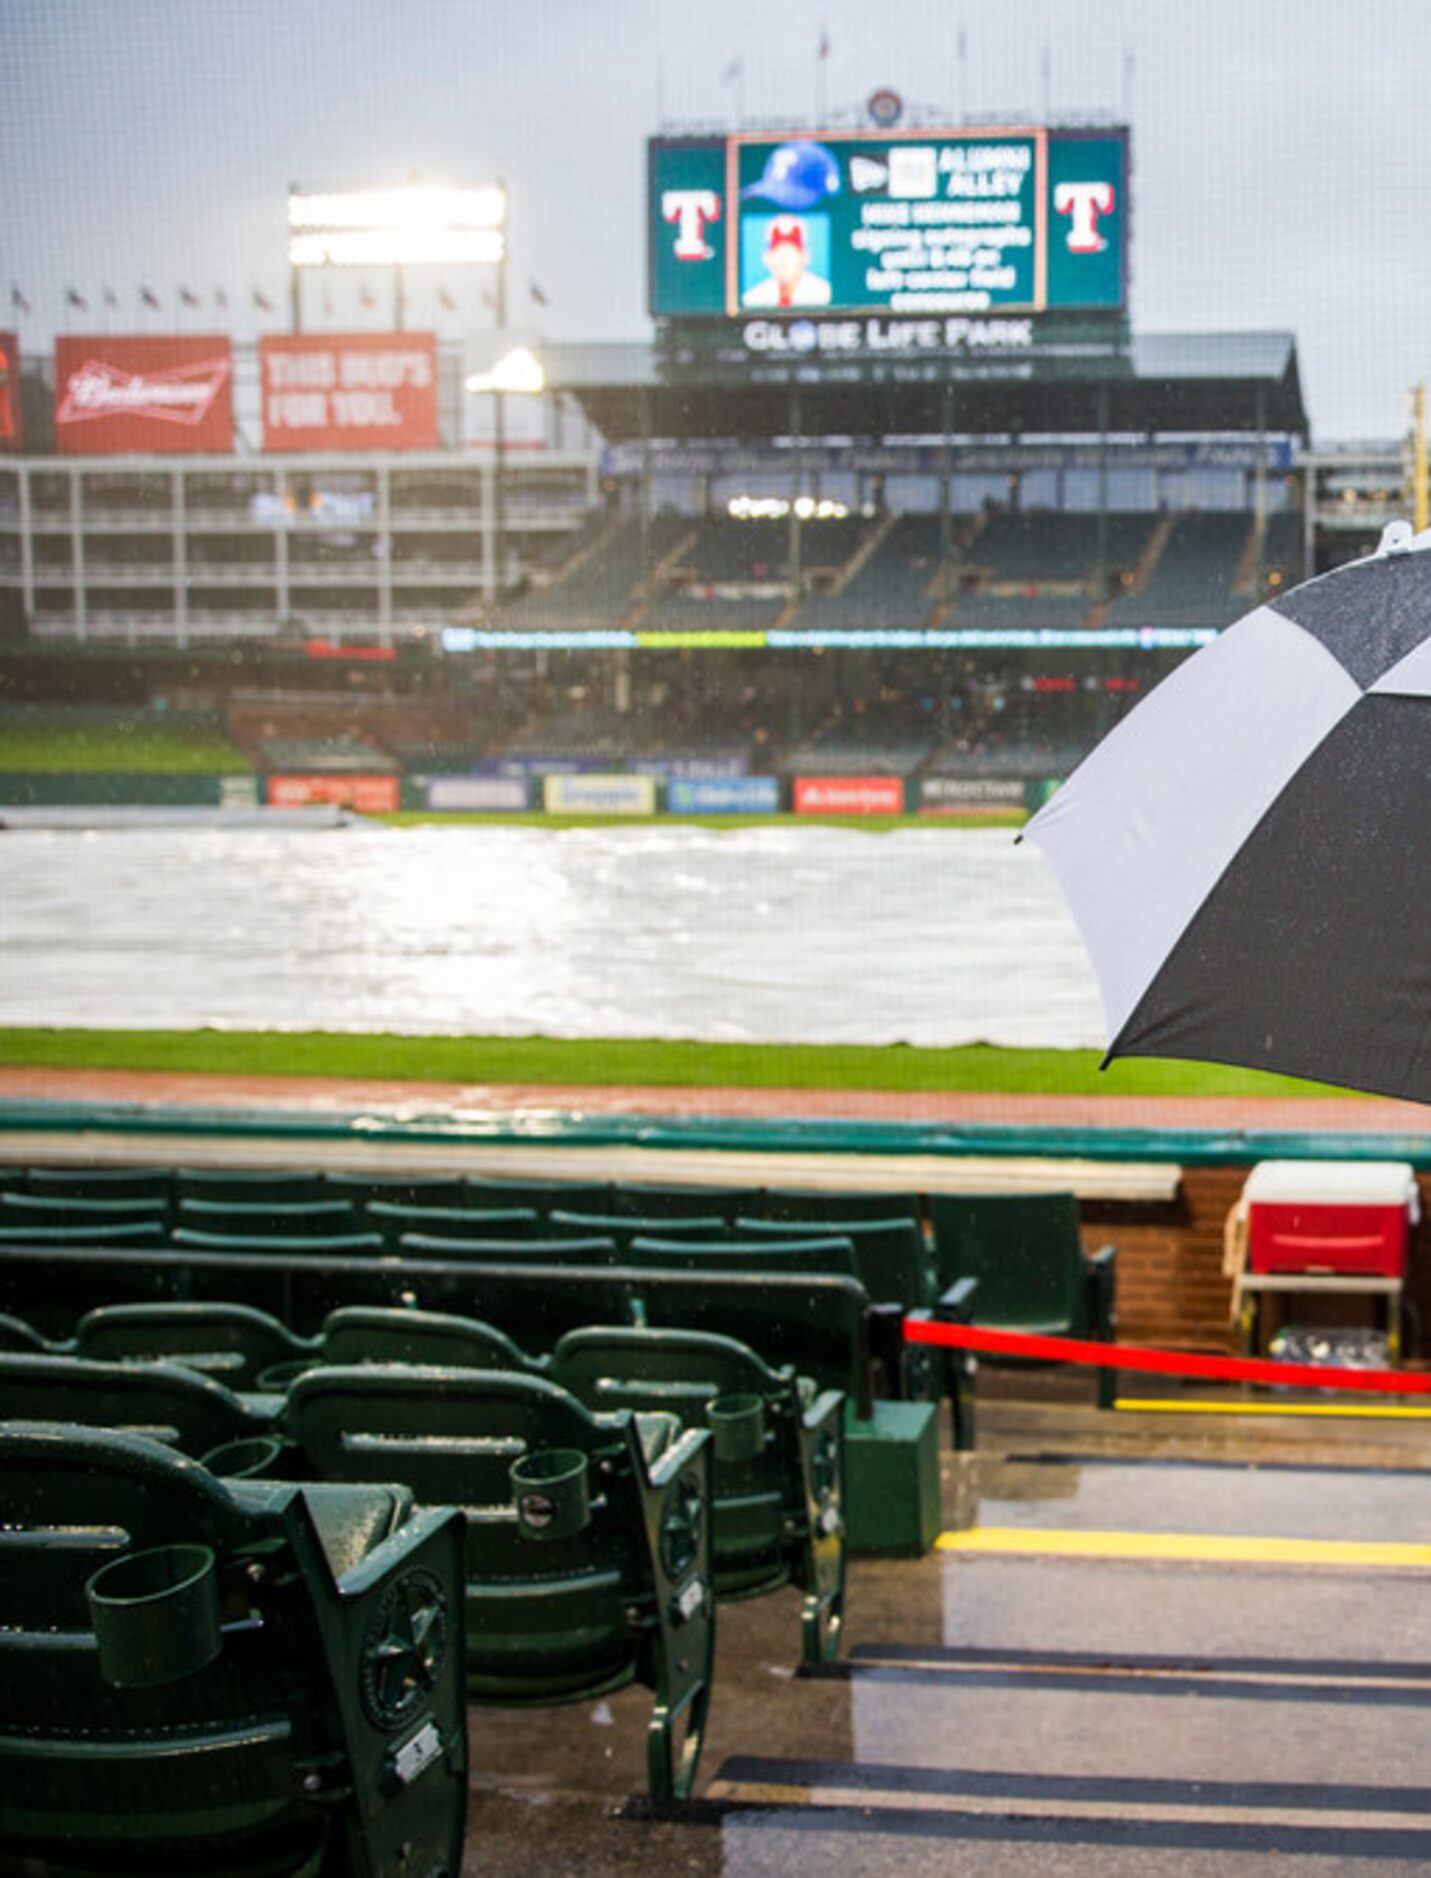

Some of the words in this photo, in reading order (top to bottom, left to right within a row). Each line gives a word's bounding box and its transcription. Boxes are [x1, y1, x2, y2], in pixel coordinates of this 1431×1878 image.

[947, 172, 1024, 197] ALLEY
[662, 189, 720, 261] T
[1054, 181, 1115, 253] T
[743, 319, 861, 352] GLOBE
[866, 318, 940, 348] LIFE
[945, 316, 1033, 348] PARK
[67, 370, 213, 406] Budweiser
[266, 352, 336, 388] THIS
[267, 391, 329, 428] FOR
